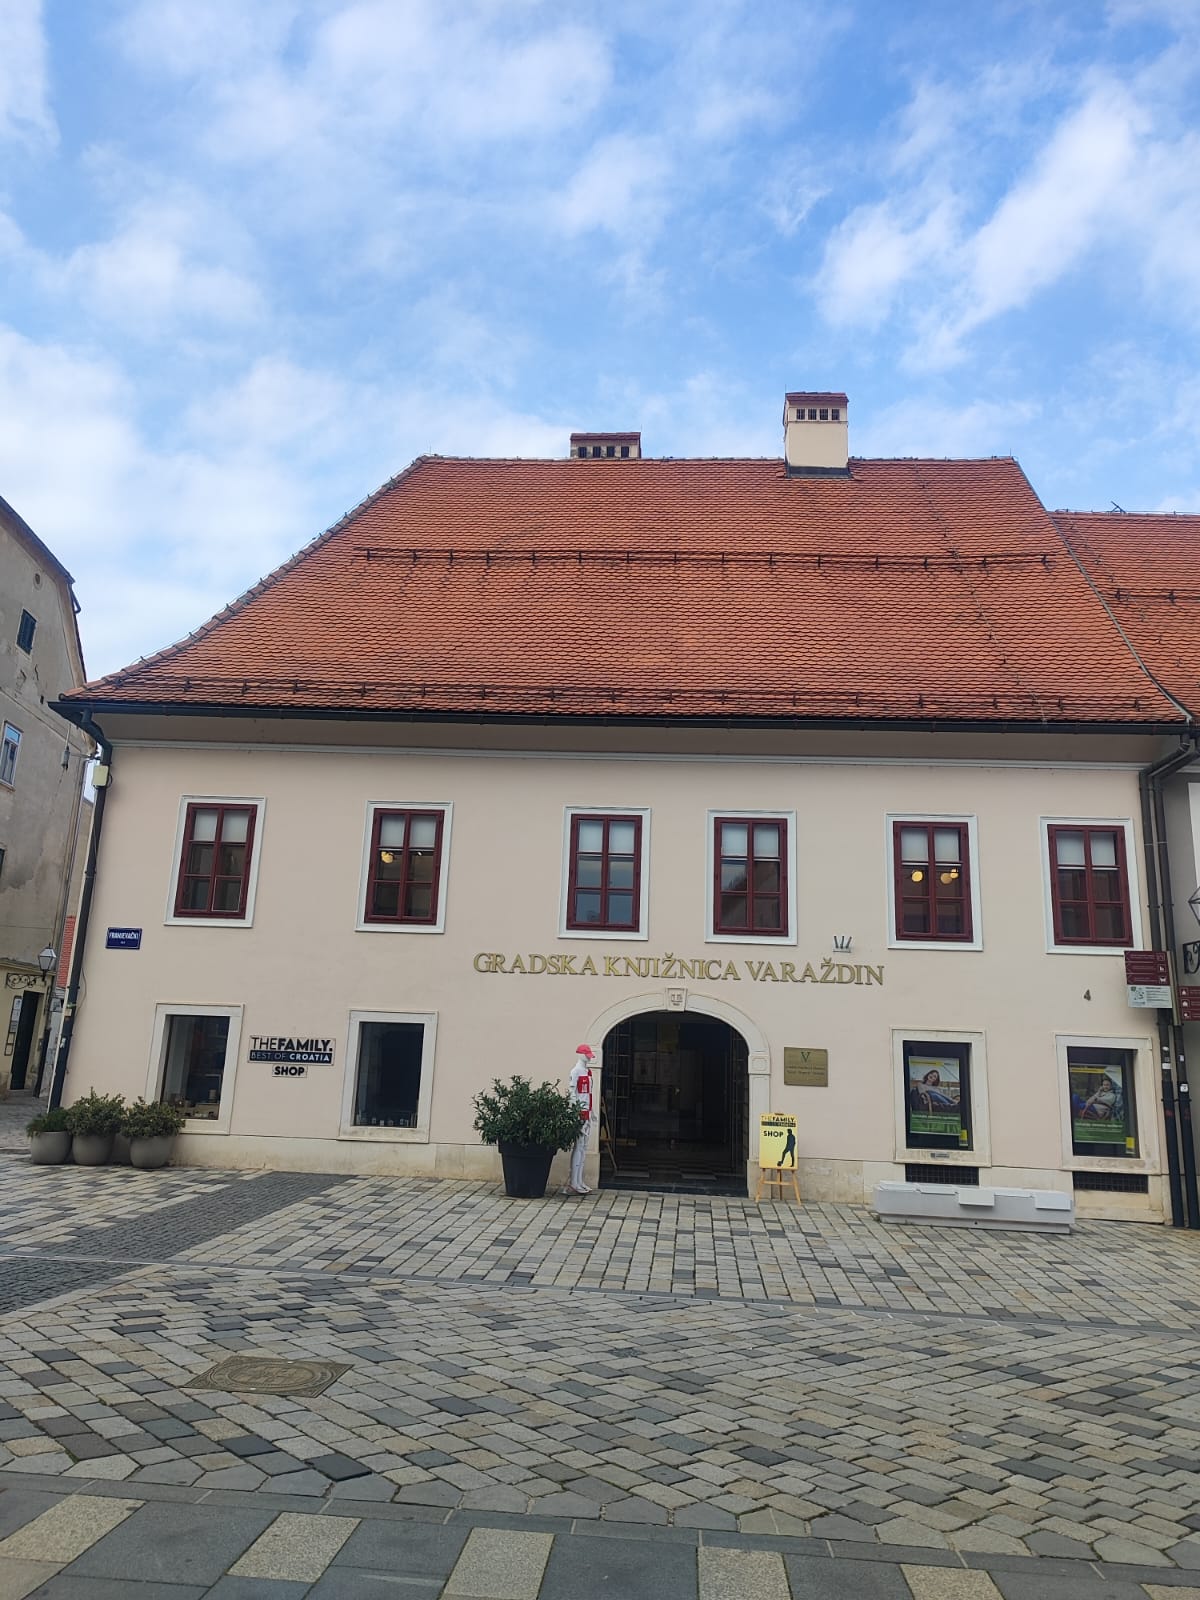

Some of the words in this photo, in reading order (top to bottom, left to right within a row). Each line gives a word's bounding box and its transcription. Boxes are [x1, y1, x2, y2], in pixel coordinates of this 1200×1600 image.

[473, 953, 598, 976] GRADSKA
[603, 952, 741, 981] KNJIŽNICA
[745, 957, 885, 985] VARAŽDIN
[251, 1052, 271, 1060] BEST
[274, 1052, 287, 1060] OF
[289, 1053, 330, 1061] CROATIA
[274, 1066, 305, 1076] SHOP
[763, 1130, 784, 1138] SHOP
